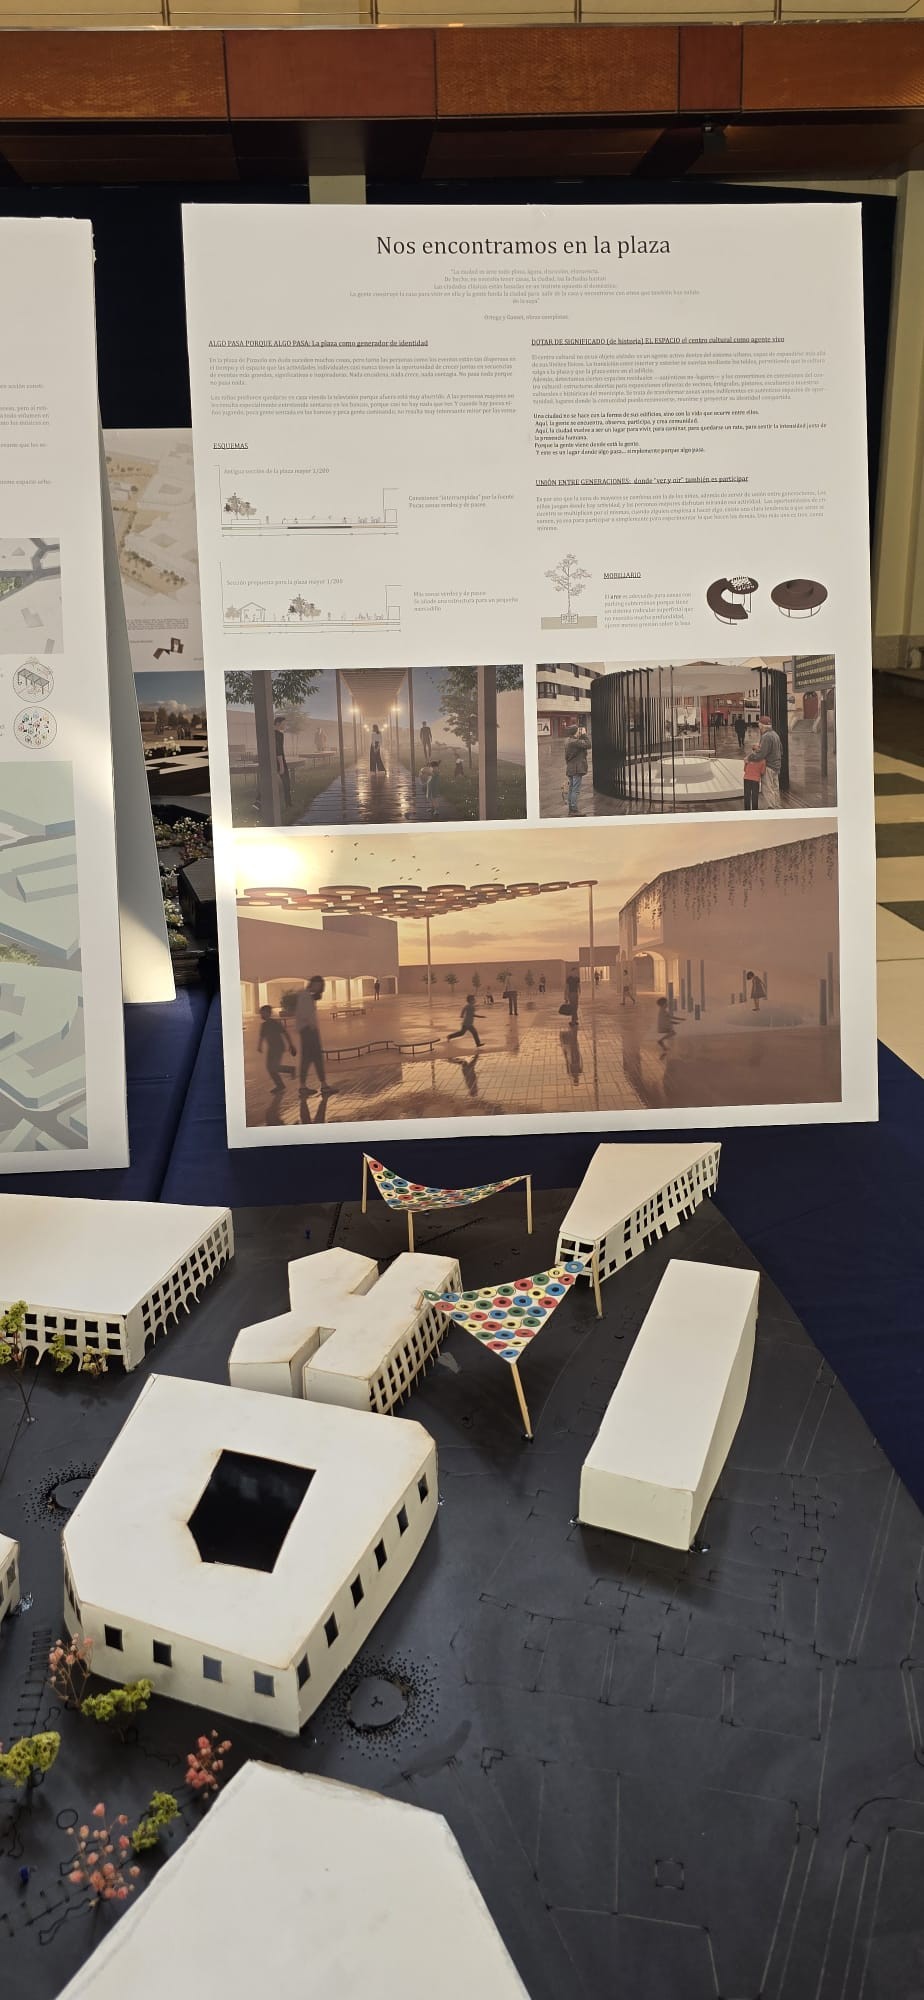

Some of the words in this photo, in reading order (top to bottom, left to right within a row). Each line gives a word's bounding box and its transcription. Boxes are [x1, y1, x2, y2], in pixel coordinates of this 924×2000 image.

[377, 236, 416, 254] Nos
[422, 238, 557, 254] encontramos
[563, 240, 588, 254] en
[594, 236, 612, 254] la
[617, 235, 671, 258] plaza
